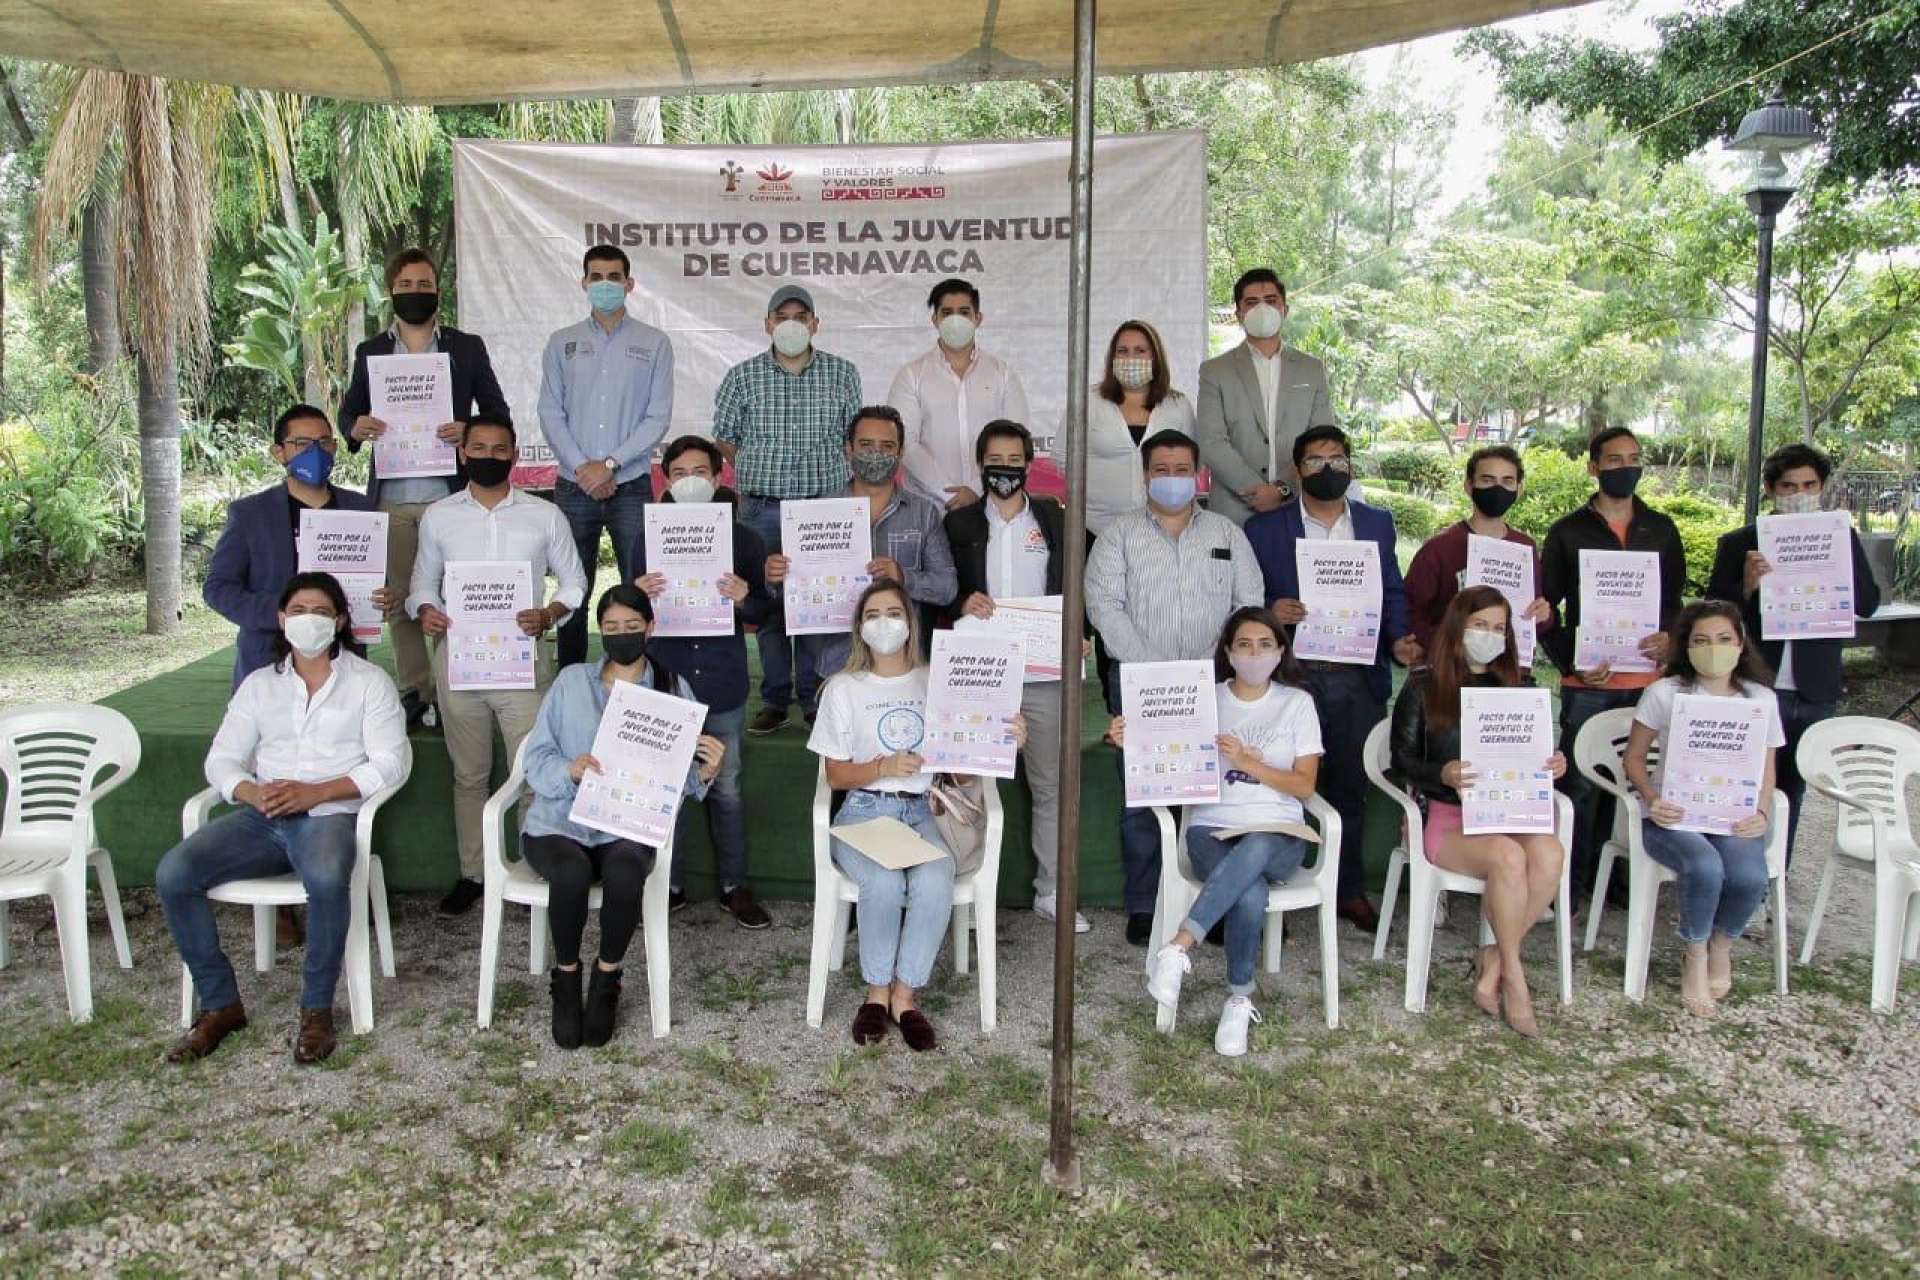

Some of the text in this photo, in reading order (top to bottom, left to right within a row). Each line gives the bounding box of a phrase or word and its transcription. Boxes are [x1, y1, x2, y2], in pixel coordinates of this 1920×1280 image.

[822, 165, 945, 177] BIENESTAR SOCIAL
[822, 178, 893, 187] Y VALORES
[585, 216, 1073, 247] INSTITUTO DE LA JUVENTUD
[684, 248, 986, 277] DE CUERNAVACA
[384, 383, 435, 394] JUVENTUD DE
[663, 536, 714, 545] JUVENTUD DE
[800, 531, 852, 542] JUVENTUD DE
[318, 543, 369, 552] JUVENTUD DE
[1596, 580, 1644, 589] JUVENTUD DE
[464, 593, 514, 602] JUVENTUD DE
[949, 667, 1005, 677] JUVENTUD DE
[1141, 696, 1197, 707] JUVENTUD DE
[620, 721, 680, 743] JUVENTUD DE
[1480, 724, 1533, 733] JUVENTUD DE
[1689, 730, 1747, 741] JUVENTUD DE
